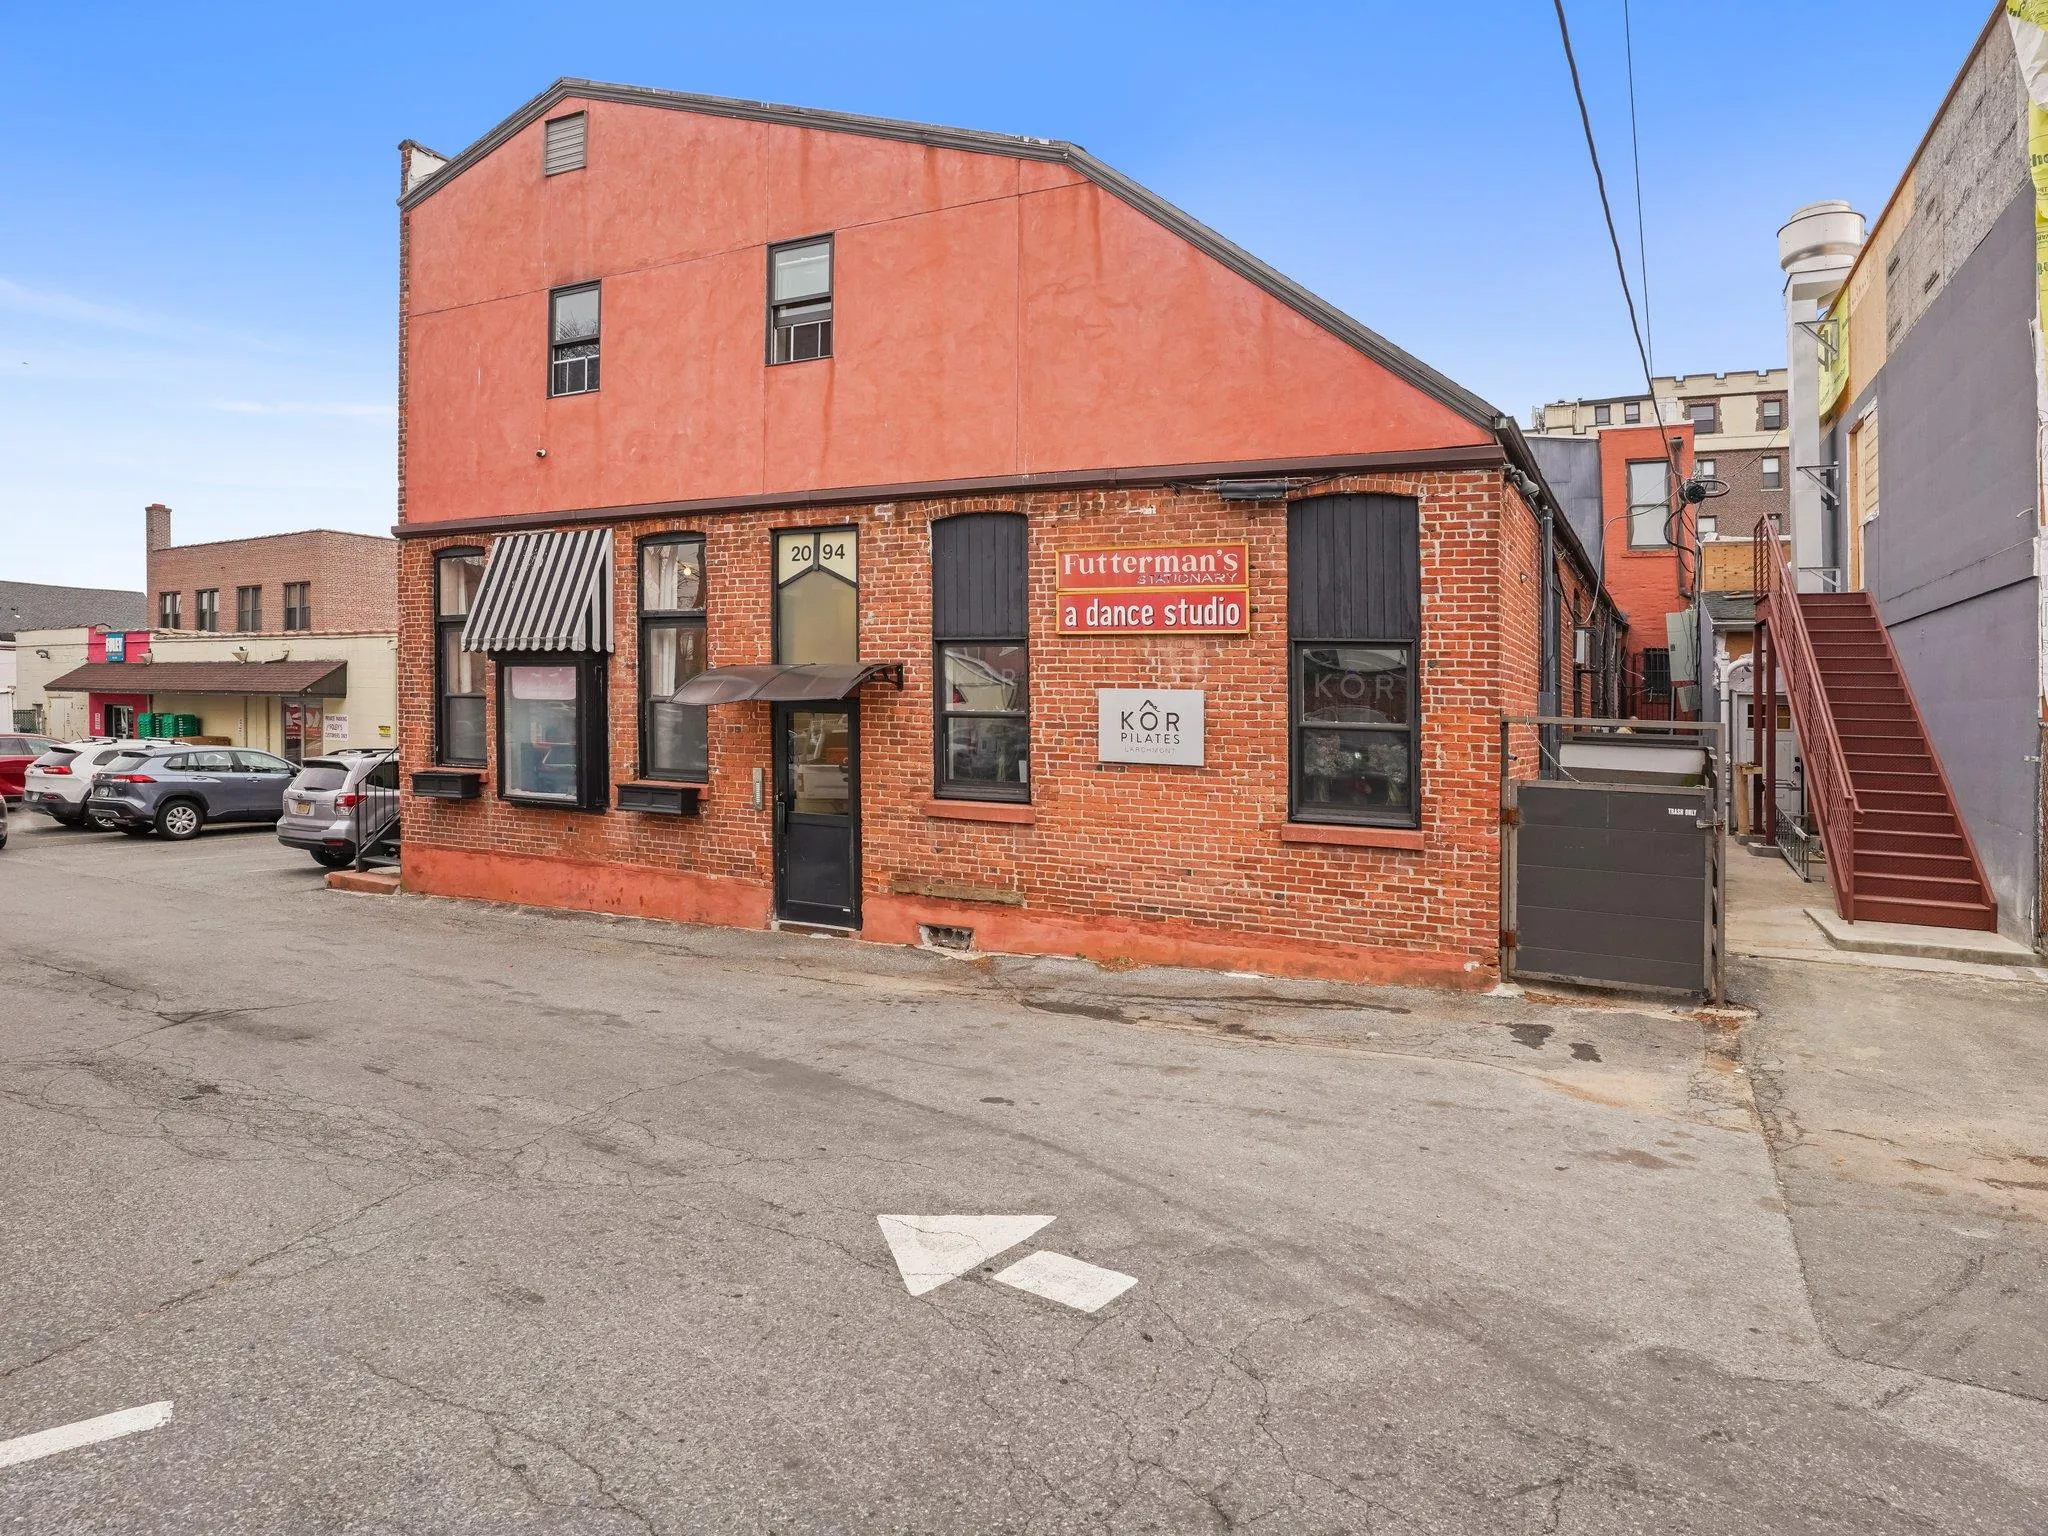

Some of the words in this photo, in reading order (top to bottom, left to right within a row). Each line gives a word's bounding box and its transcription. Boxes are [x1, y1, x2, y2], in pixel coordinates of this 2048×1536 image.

[1064, 549, 1239, 575] Futterman's
[1137, 573, 1238, 585] STATIONARY
[1064, 605, 1078, 627] a
[1086, 598, 1155, 627] dance
[1164, 596, 1241, 627] studio
[1121, 733, 1180, 745] PILATES
[1124, 747, 1176, 755] LARCHMONT
